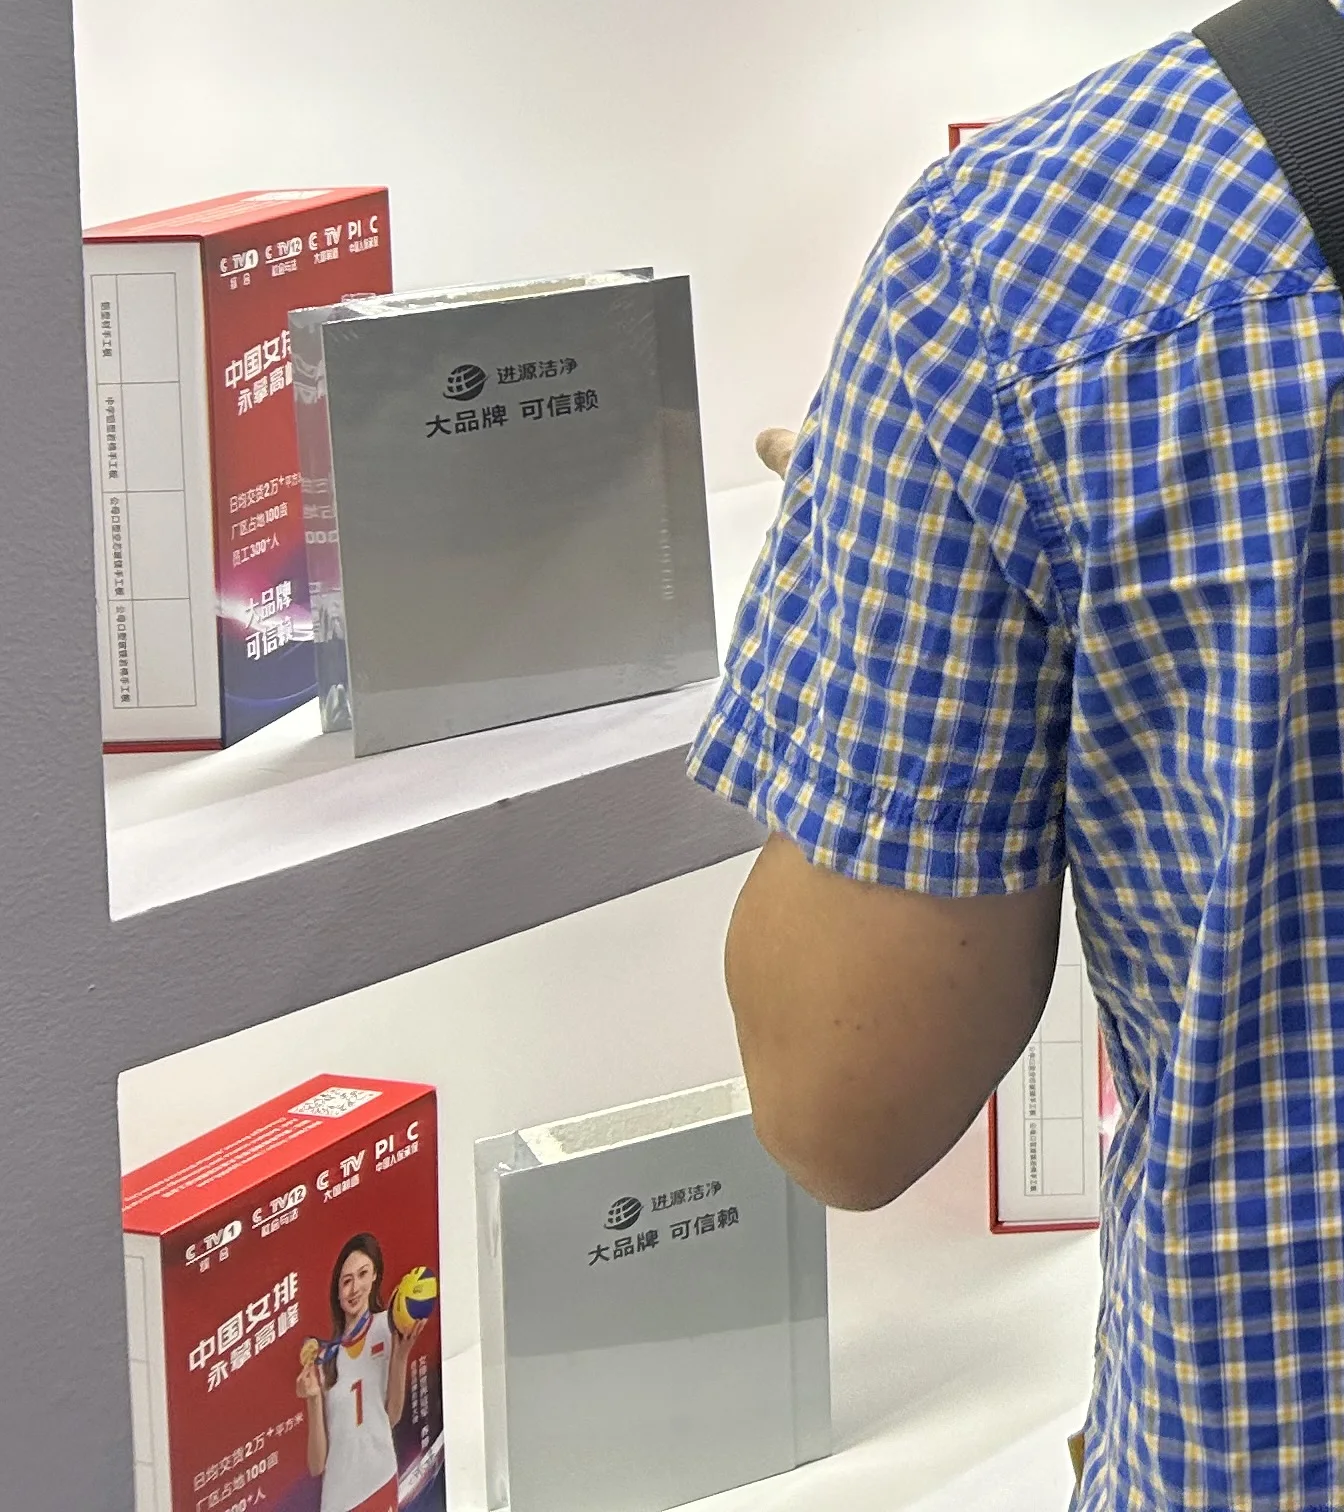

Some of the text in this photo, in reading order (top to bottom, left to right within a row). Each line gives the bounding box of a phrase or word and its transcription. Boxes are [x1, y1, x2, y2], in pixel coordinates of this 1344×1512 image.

[496, 356, 579, 385] 进源洁净
[425, 388, 600, 439] 大品牌 可信赖
[244, 579, 293, 630] 大品牌
[244, 616, 294, 661] 可信赖
[651, 1179, 723, 1214] 进源洁净
[587, 1204, 740, 1268] 大品牌 可信赖
[188, 1270, 300, 1373] 中国女排
[207, 1301, 300, 1393] 永攀高峰
[349, 1378, 364, 1429] 1
